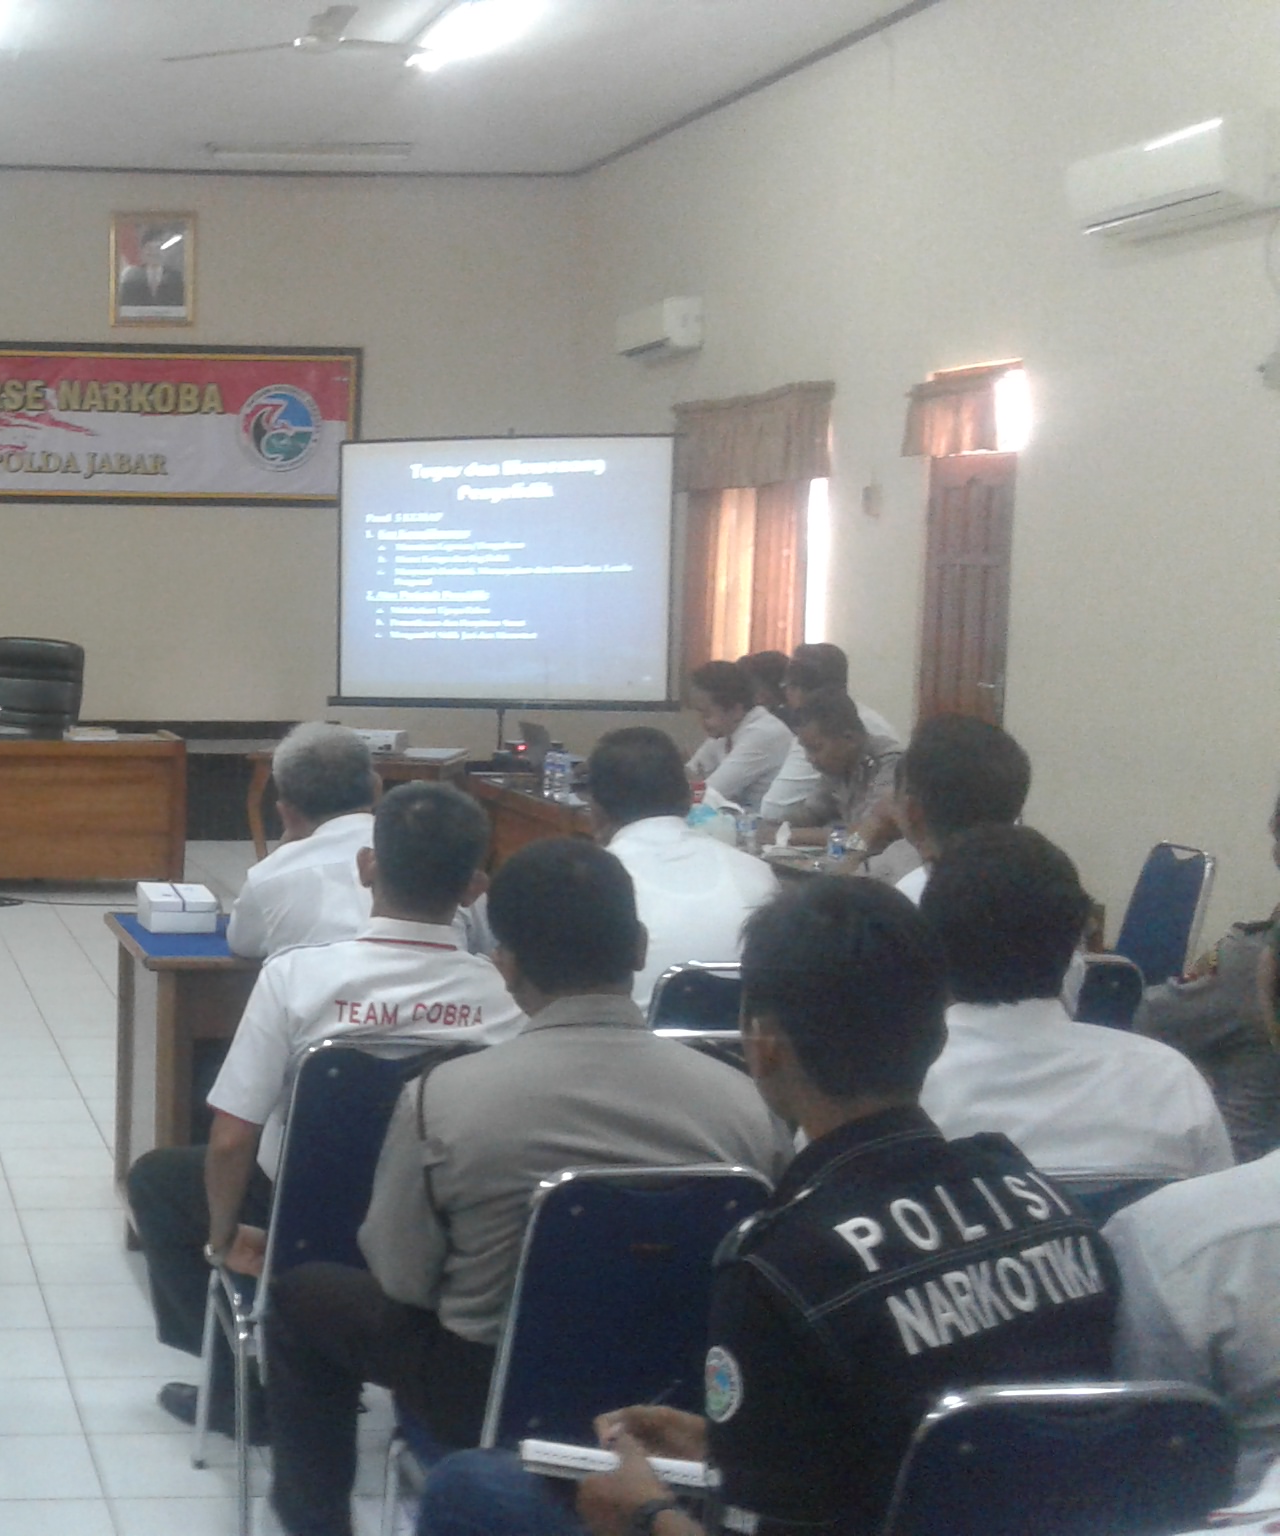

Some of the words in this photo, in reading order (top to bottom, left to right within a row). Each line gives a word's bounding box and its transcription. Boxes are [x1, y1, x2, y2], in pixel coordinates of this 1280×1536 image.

[56, 379, 225, 415] NARKOBA
[83, 452, 169, 479] JABAR
[334, 999, 400, 1026] TEAM
[411, 1002, 484, 1027] COBRA
[832, 1171, 1072, 1273] POLISI
